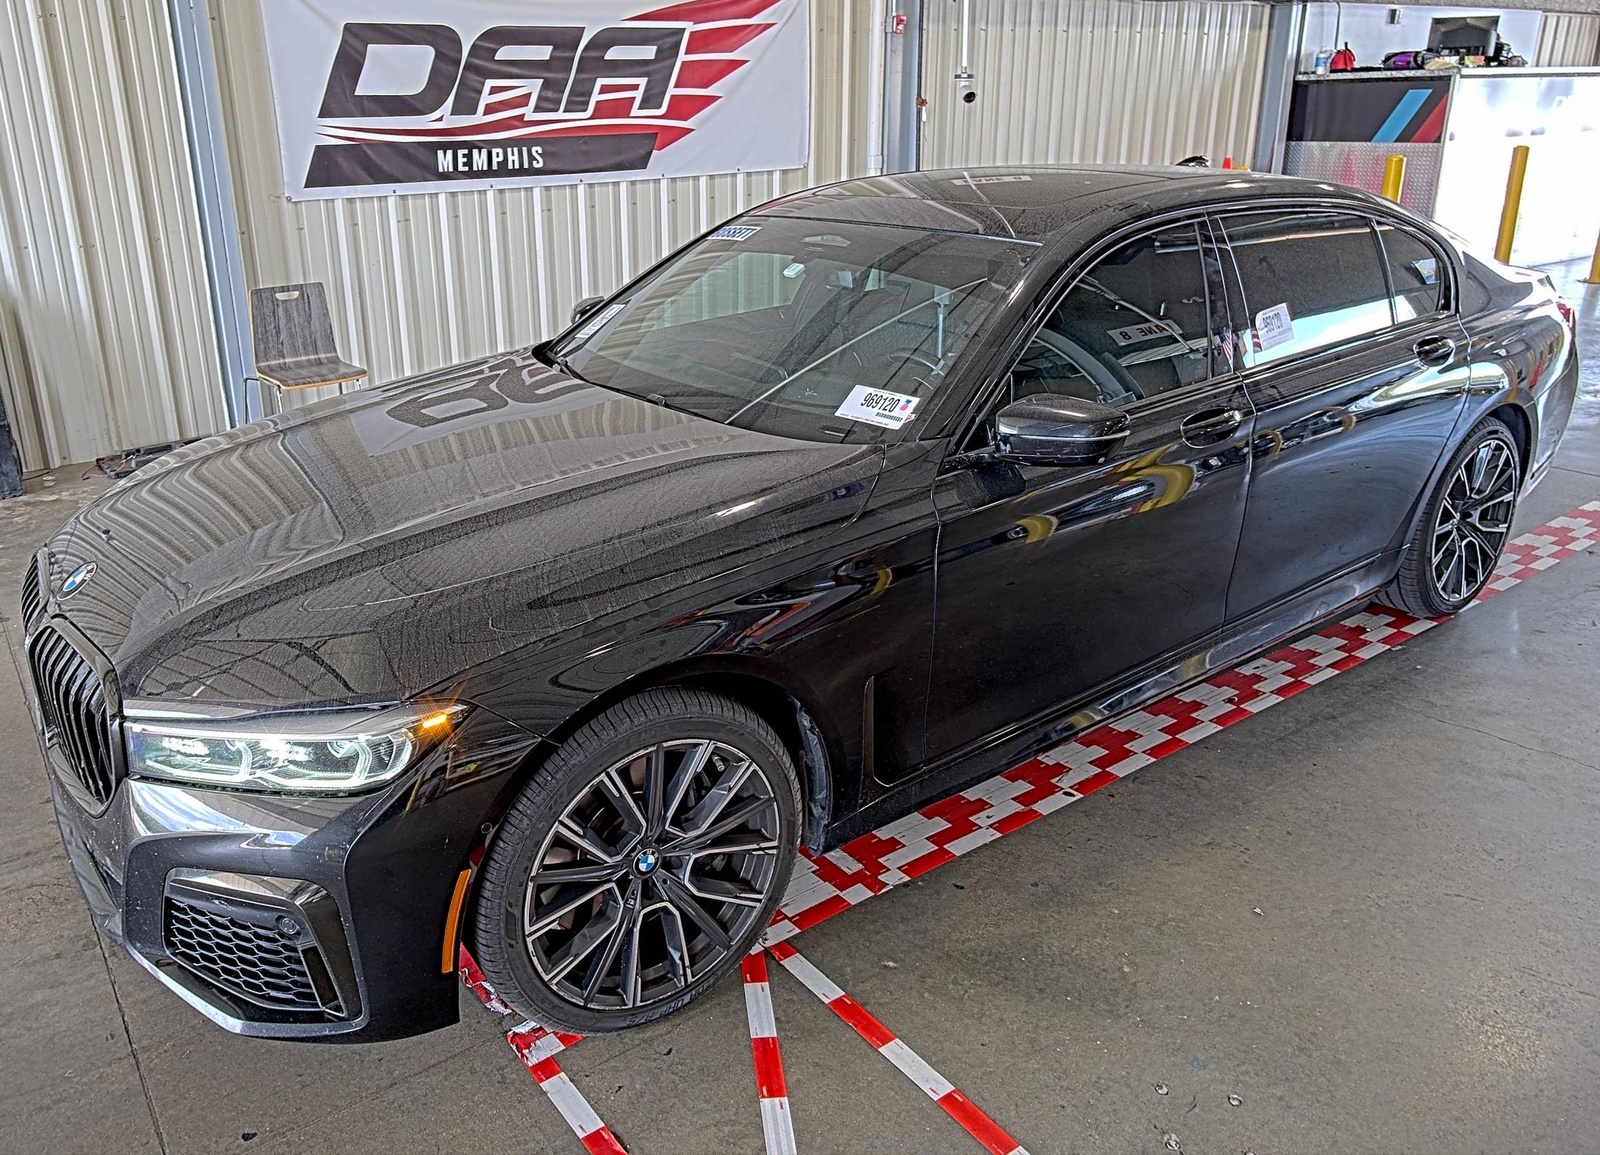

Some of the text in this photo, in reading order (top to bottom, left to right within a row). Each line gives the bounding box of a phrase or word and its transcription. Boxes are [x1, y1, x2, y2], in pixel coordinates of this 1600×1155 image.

[317, 22, 686, 117] DAA
[437, 146, 544, 172] MEMPHIS
[860, 392, 901, 413] 969120
